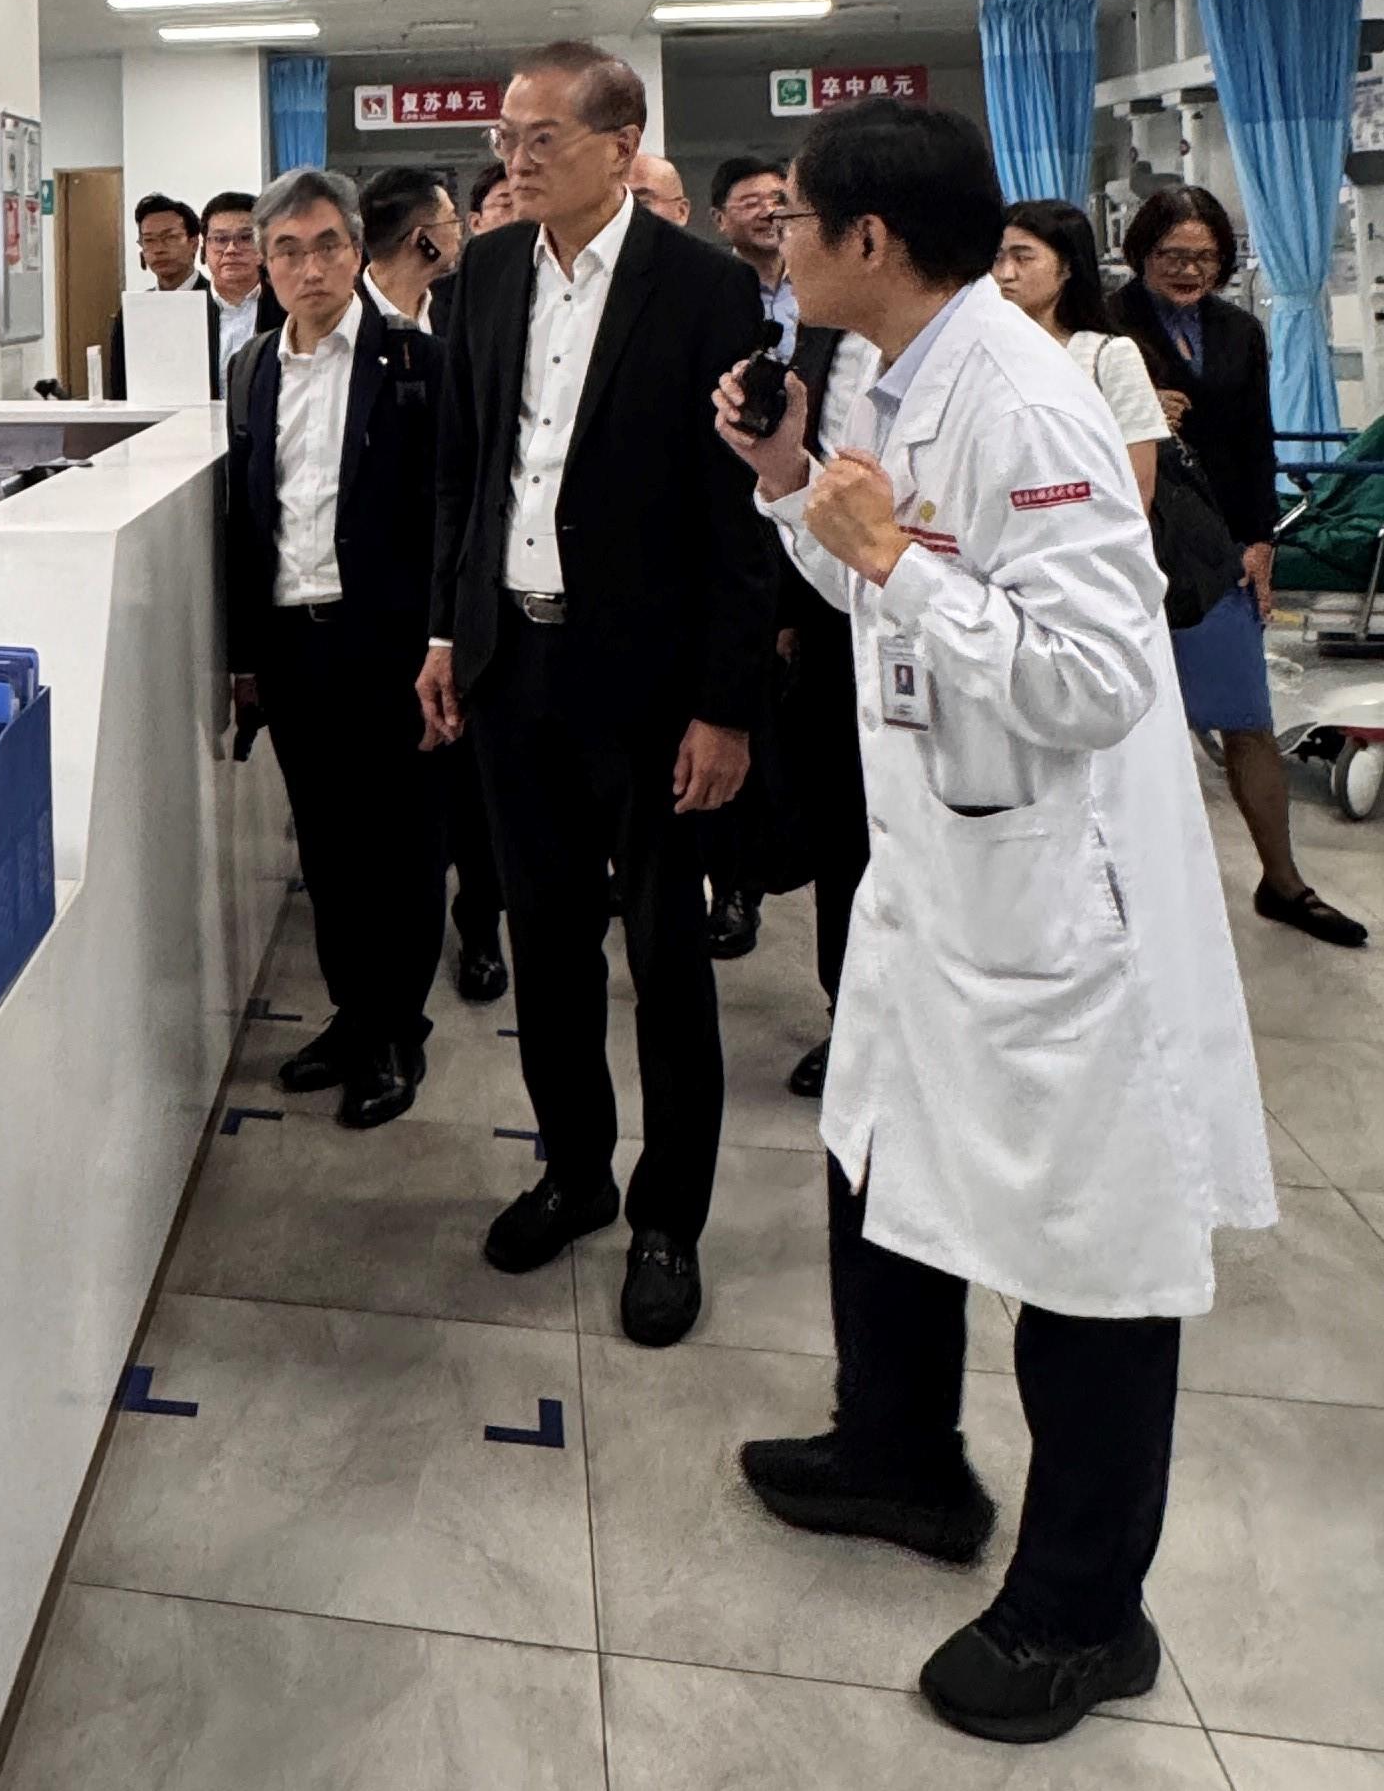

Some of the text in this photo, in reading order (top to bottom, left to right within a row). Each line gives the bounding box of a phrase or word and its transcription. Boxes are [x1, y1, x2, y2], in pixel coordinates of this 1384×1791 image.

[821, 75, 914, 98] 卒中单元
[401, 90, 486, 113] 复苏单元
